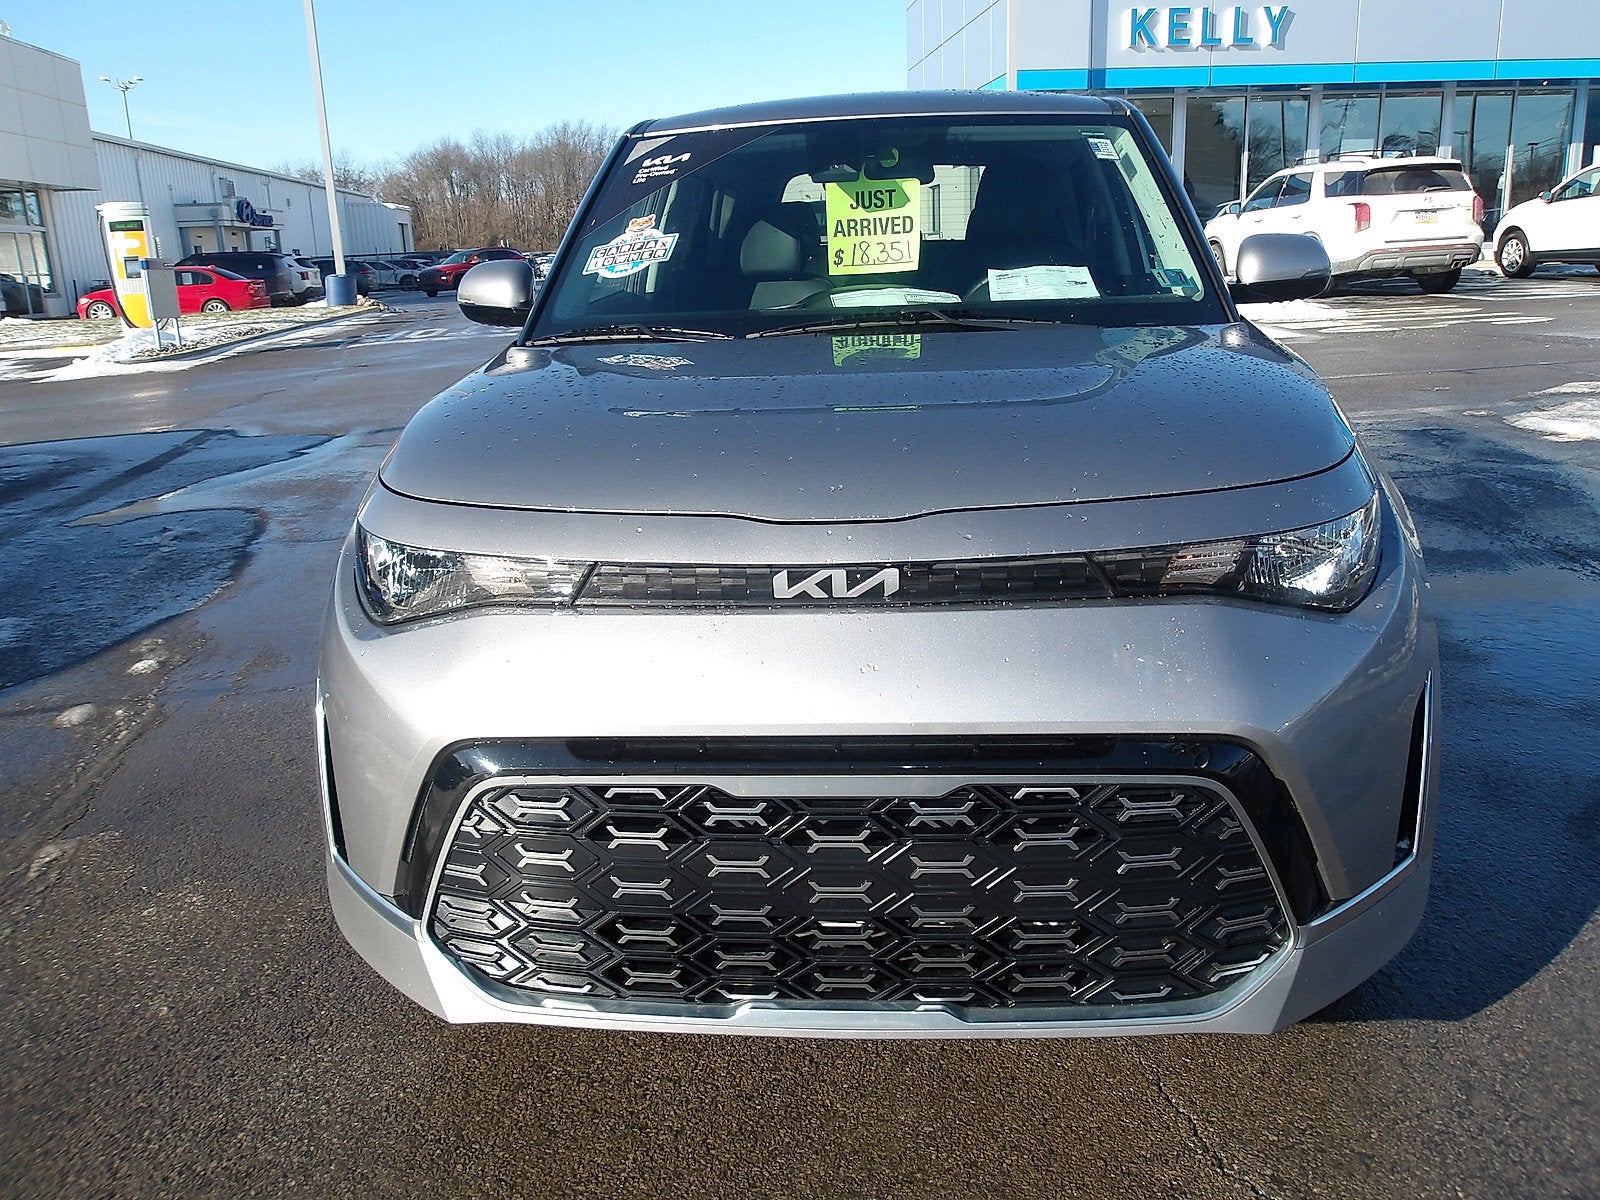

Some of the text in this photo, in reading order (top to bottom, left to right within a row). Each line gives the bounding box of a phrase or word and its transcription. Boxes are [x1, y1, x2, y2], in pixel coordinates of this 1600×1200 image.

[1130, 6, 1289, 47] KELLY
[850, 189, 896, 210] JUST
[833, 216, 914, 237] ARRIVED
[595, 240, 669, 259] CARFAX
[773, 568, 899, 598] KIA
